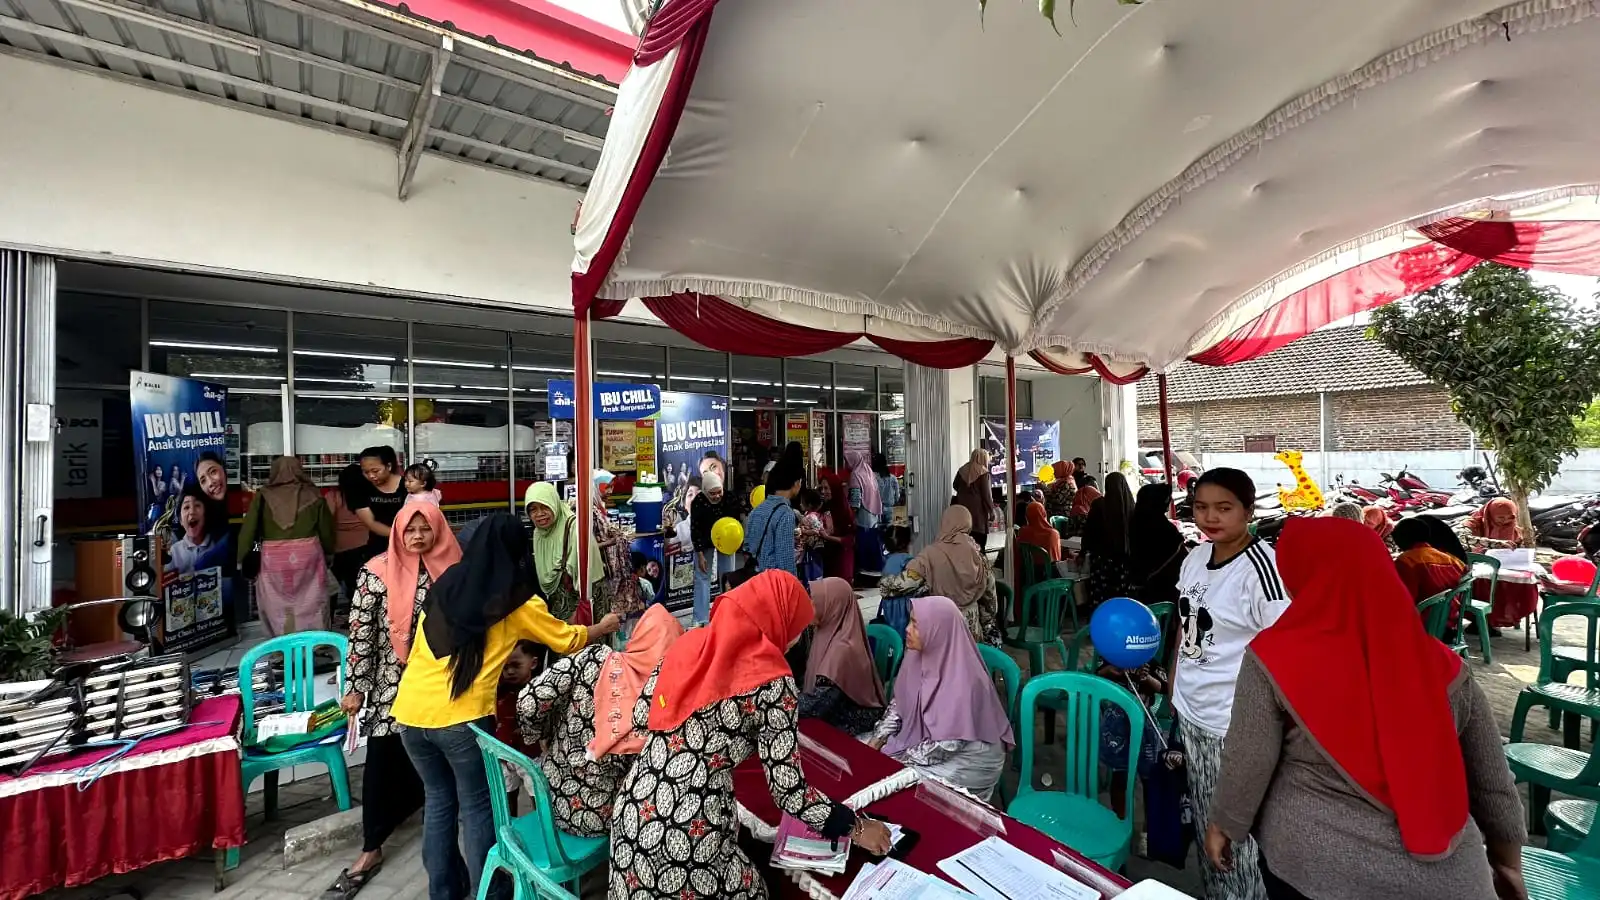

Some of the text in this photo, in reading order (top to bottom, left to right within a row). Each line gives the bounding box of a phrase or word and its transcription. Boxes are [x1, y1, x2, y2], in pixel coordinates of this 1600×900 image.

[600, 389, 654, 406] IBU CHILL
[621, 403, 656, 412] Berprestasi
[144, 411, 224, 438] IBU CHILL
[661, 419, 724, 442] IBU CHILL
[148, 435, 225, 451] Anak Berprestasi
[663, 442, 683, 452] Anak
[684, 438, 725, 450] Berprestasi
[62, 442, 89, 487] tarik
